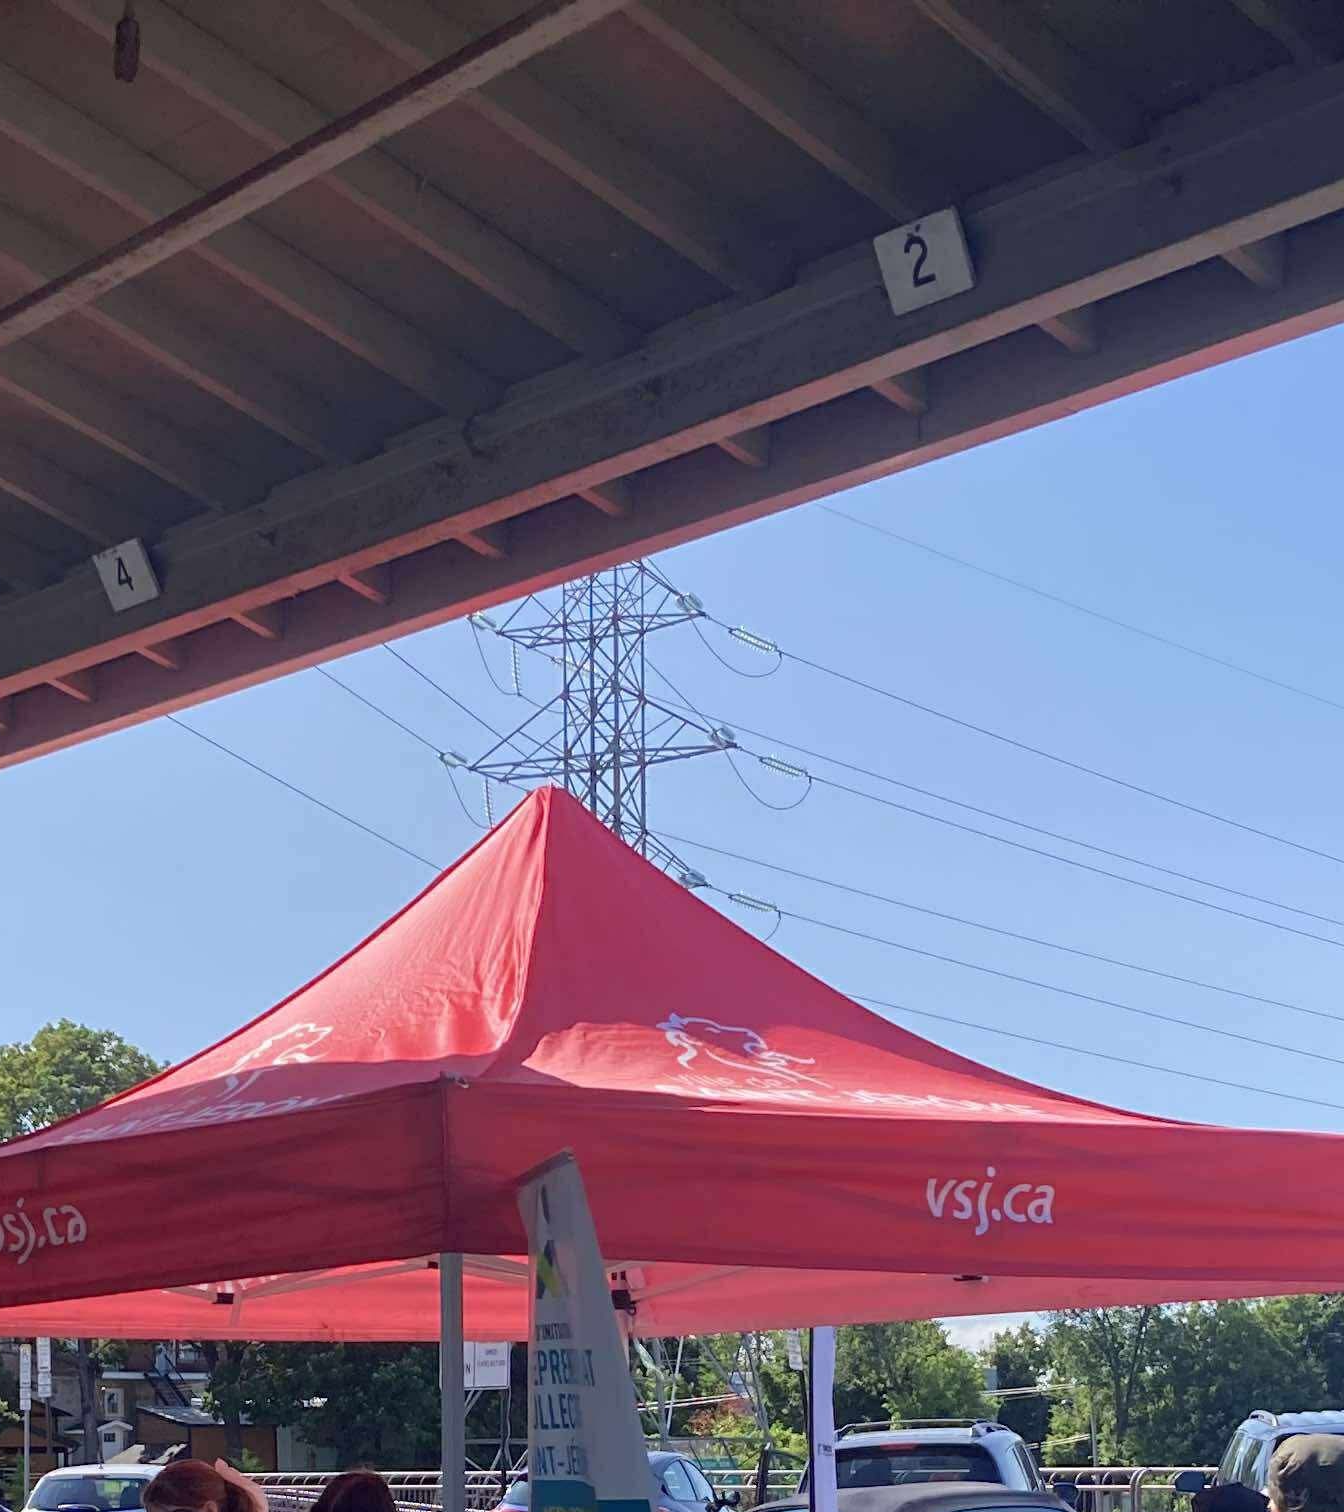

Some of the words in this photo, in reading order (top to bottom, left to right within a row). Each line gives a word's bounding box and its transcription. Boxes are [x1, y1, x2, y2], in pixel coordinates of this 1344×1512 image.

[903, 235, 937, 288] 2
[115, 556, 134, 591] 4
[926, 1165, 1055, 1236] vsj.ca
